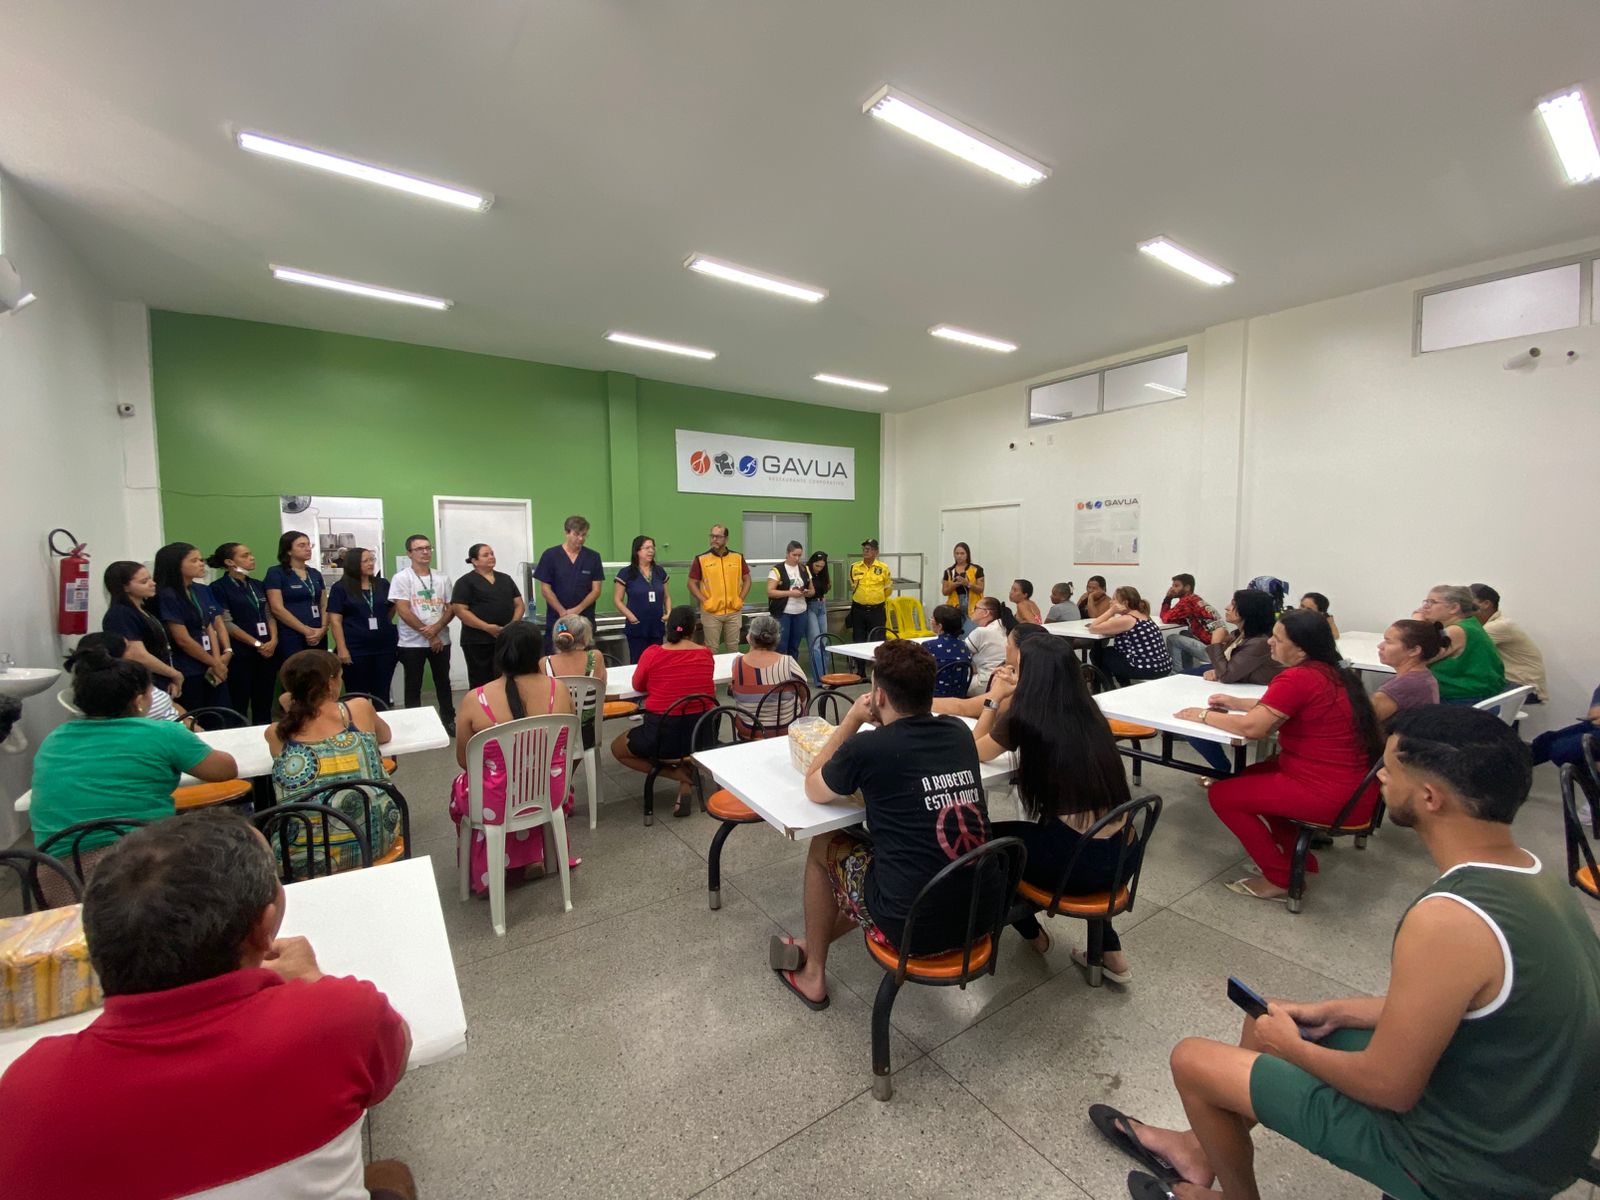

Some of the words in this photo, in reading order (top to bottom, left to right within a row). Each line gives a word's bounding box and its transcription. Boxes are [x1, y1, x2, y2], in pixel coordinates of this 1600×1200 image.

[762, 455, 848, 479] GAVUA
[1104, 498, 1139, 507] GAVUA
[921, 776, 932, 792] A
[932, 770, 974, 790] ROBERTA
[924, 789, 954, 811] ESTÁ
[953, 788, 980, 806] LOUCA
